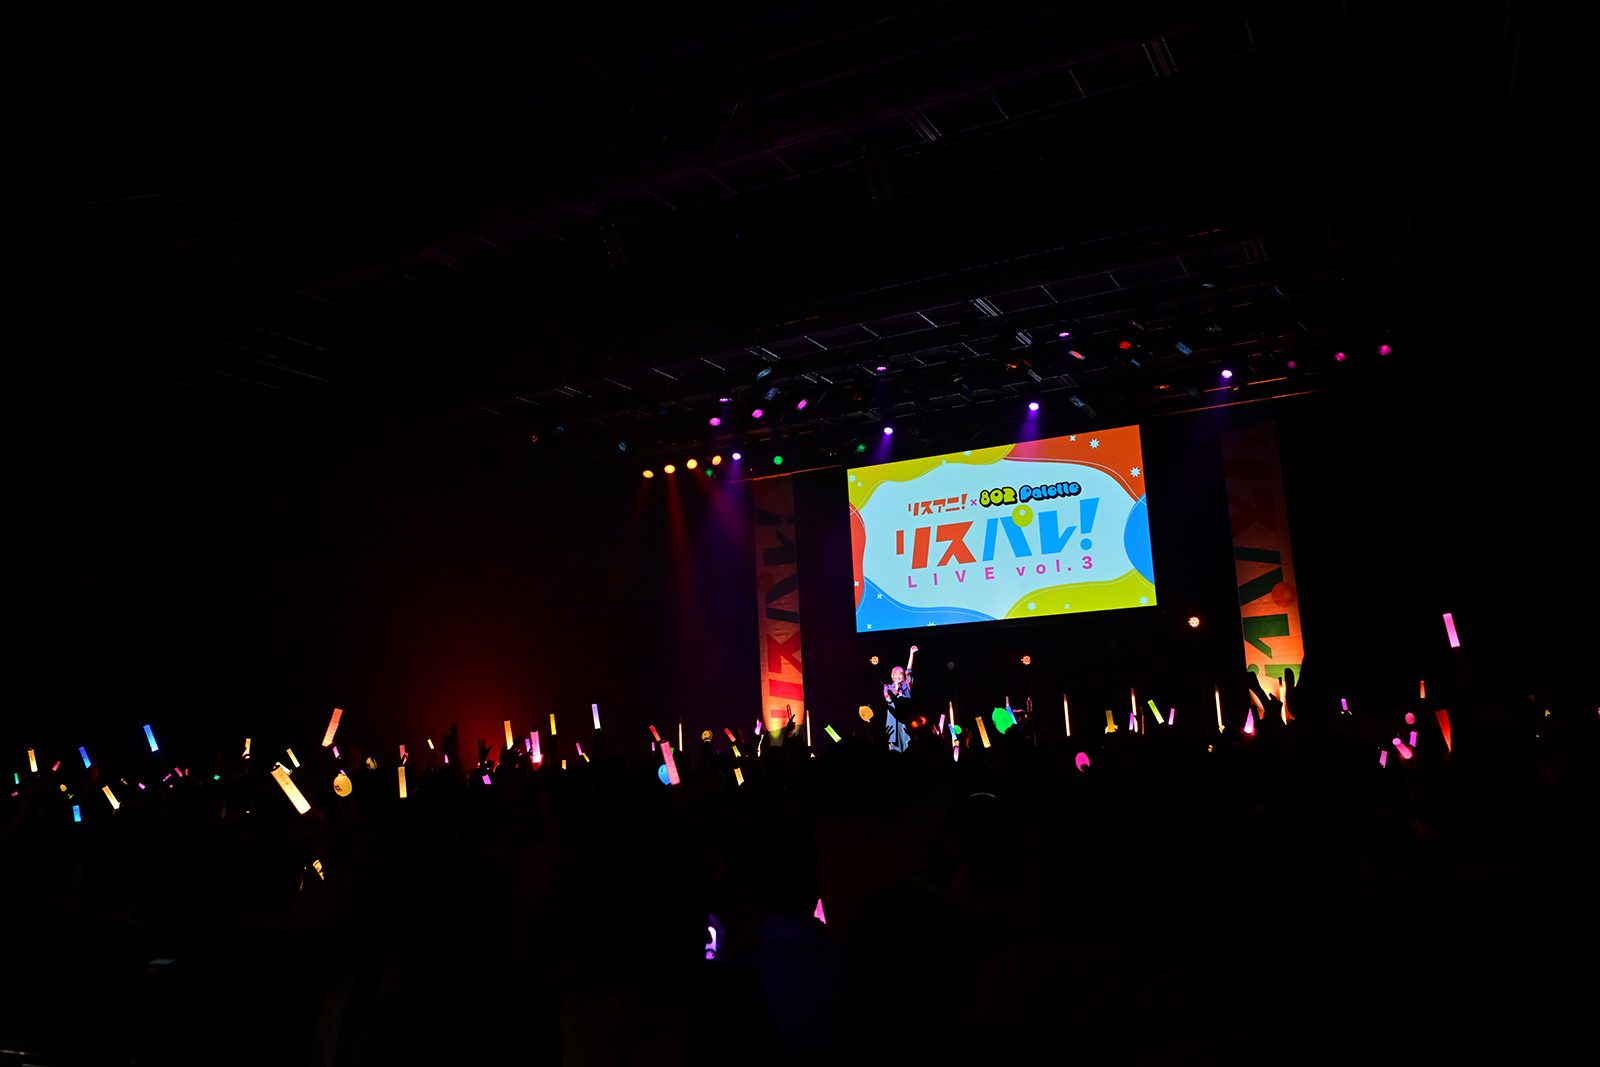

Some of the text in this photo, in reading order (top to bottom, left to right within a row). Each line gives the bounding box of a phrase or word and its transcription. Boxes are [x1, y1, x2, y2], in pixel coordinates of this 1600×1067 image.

[908, 493, 968, 516] リスアニ!
[979, 487, 1018, 508] 802
[1019, 481, 1082, 503] Palette
[896, 497, 1100, 570] リスパレ!
[908, 567, 996, 588] LIVE
